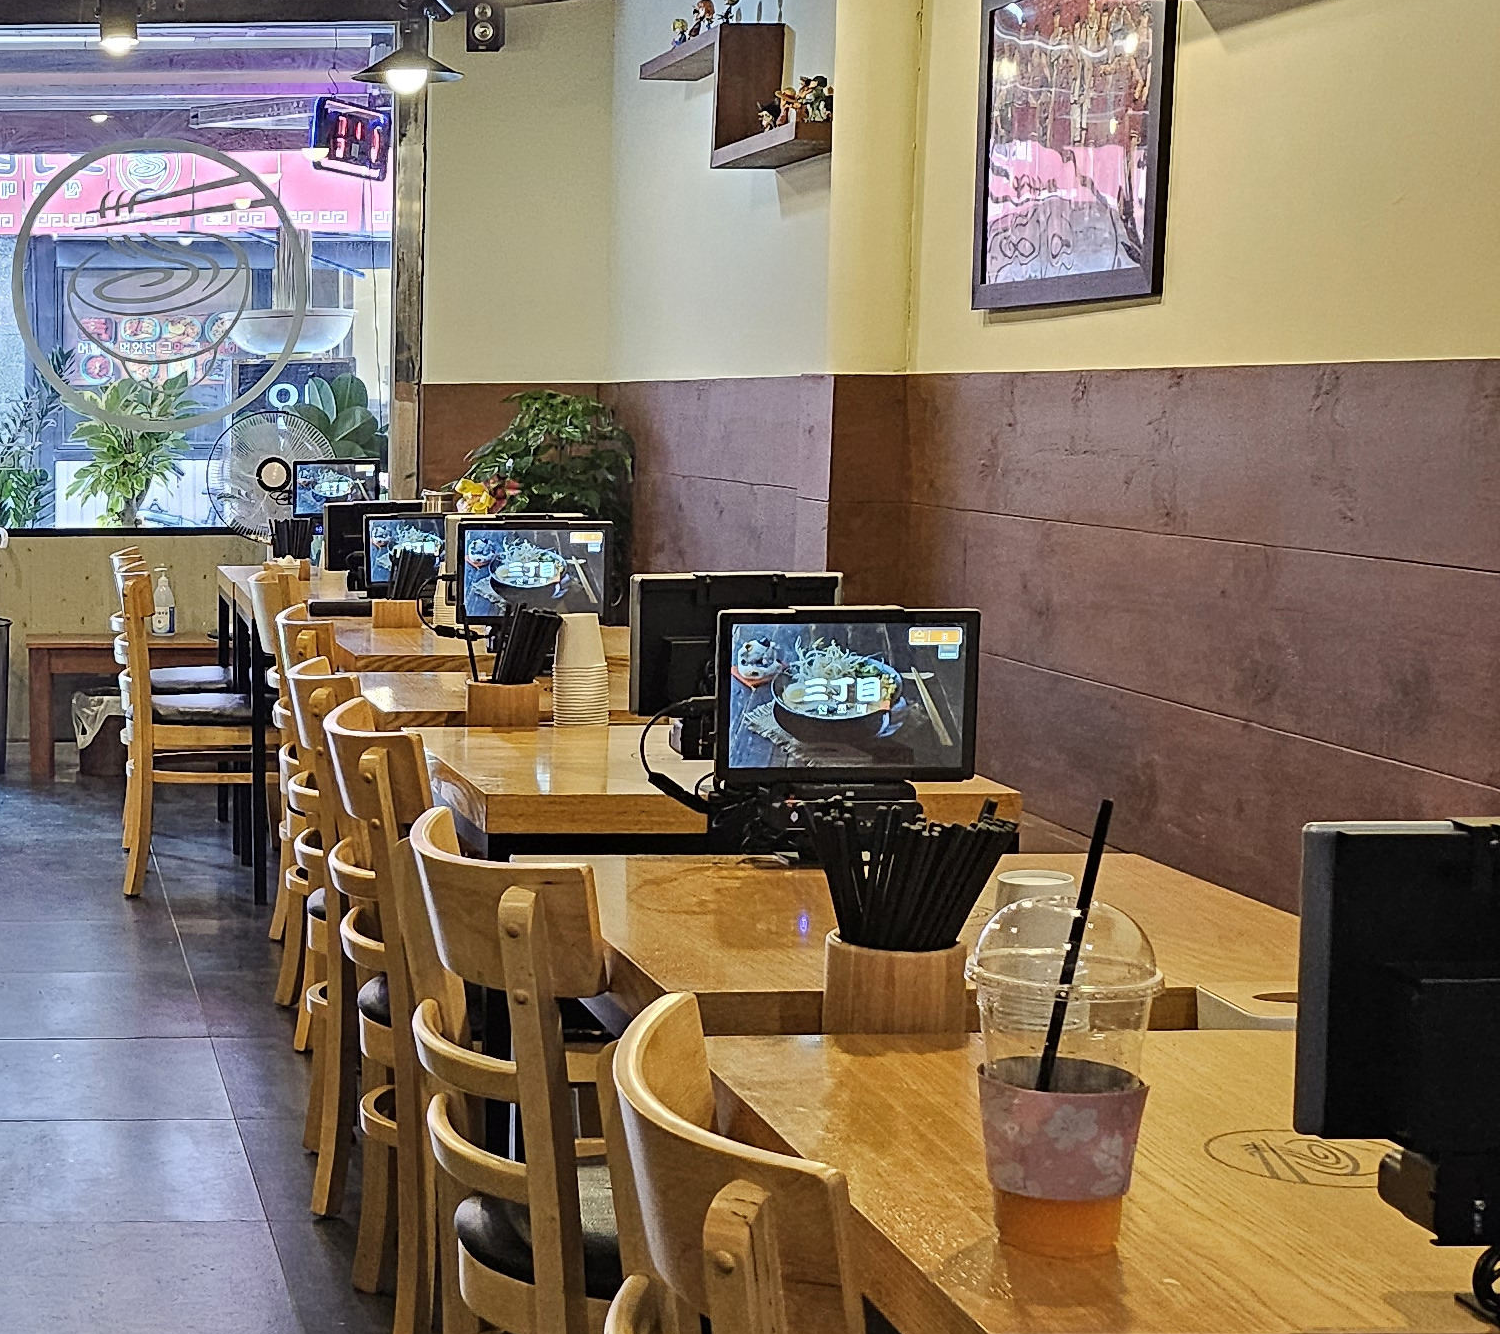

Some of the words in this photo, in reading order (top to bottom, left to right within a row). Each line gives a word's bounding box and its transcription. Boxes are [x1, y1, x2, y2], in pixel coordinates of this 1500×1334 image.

[507, 561, 555, 578] 三丁目
[802, 676, 881, 702] 三丁目
